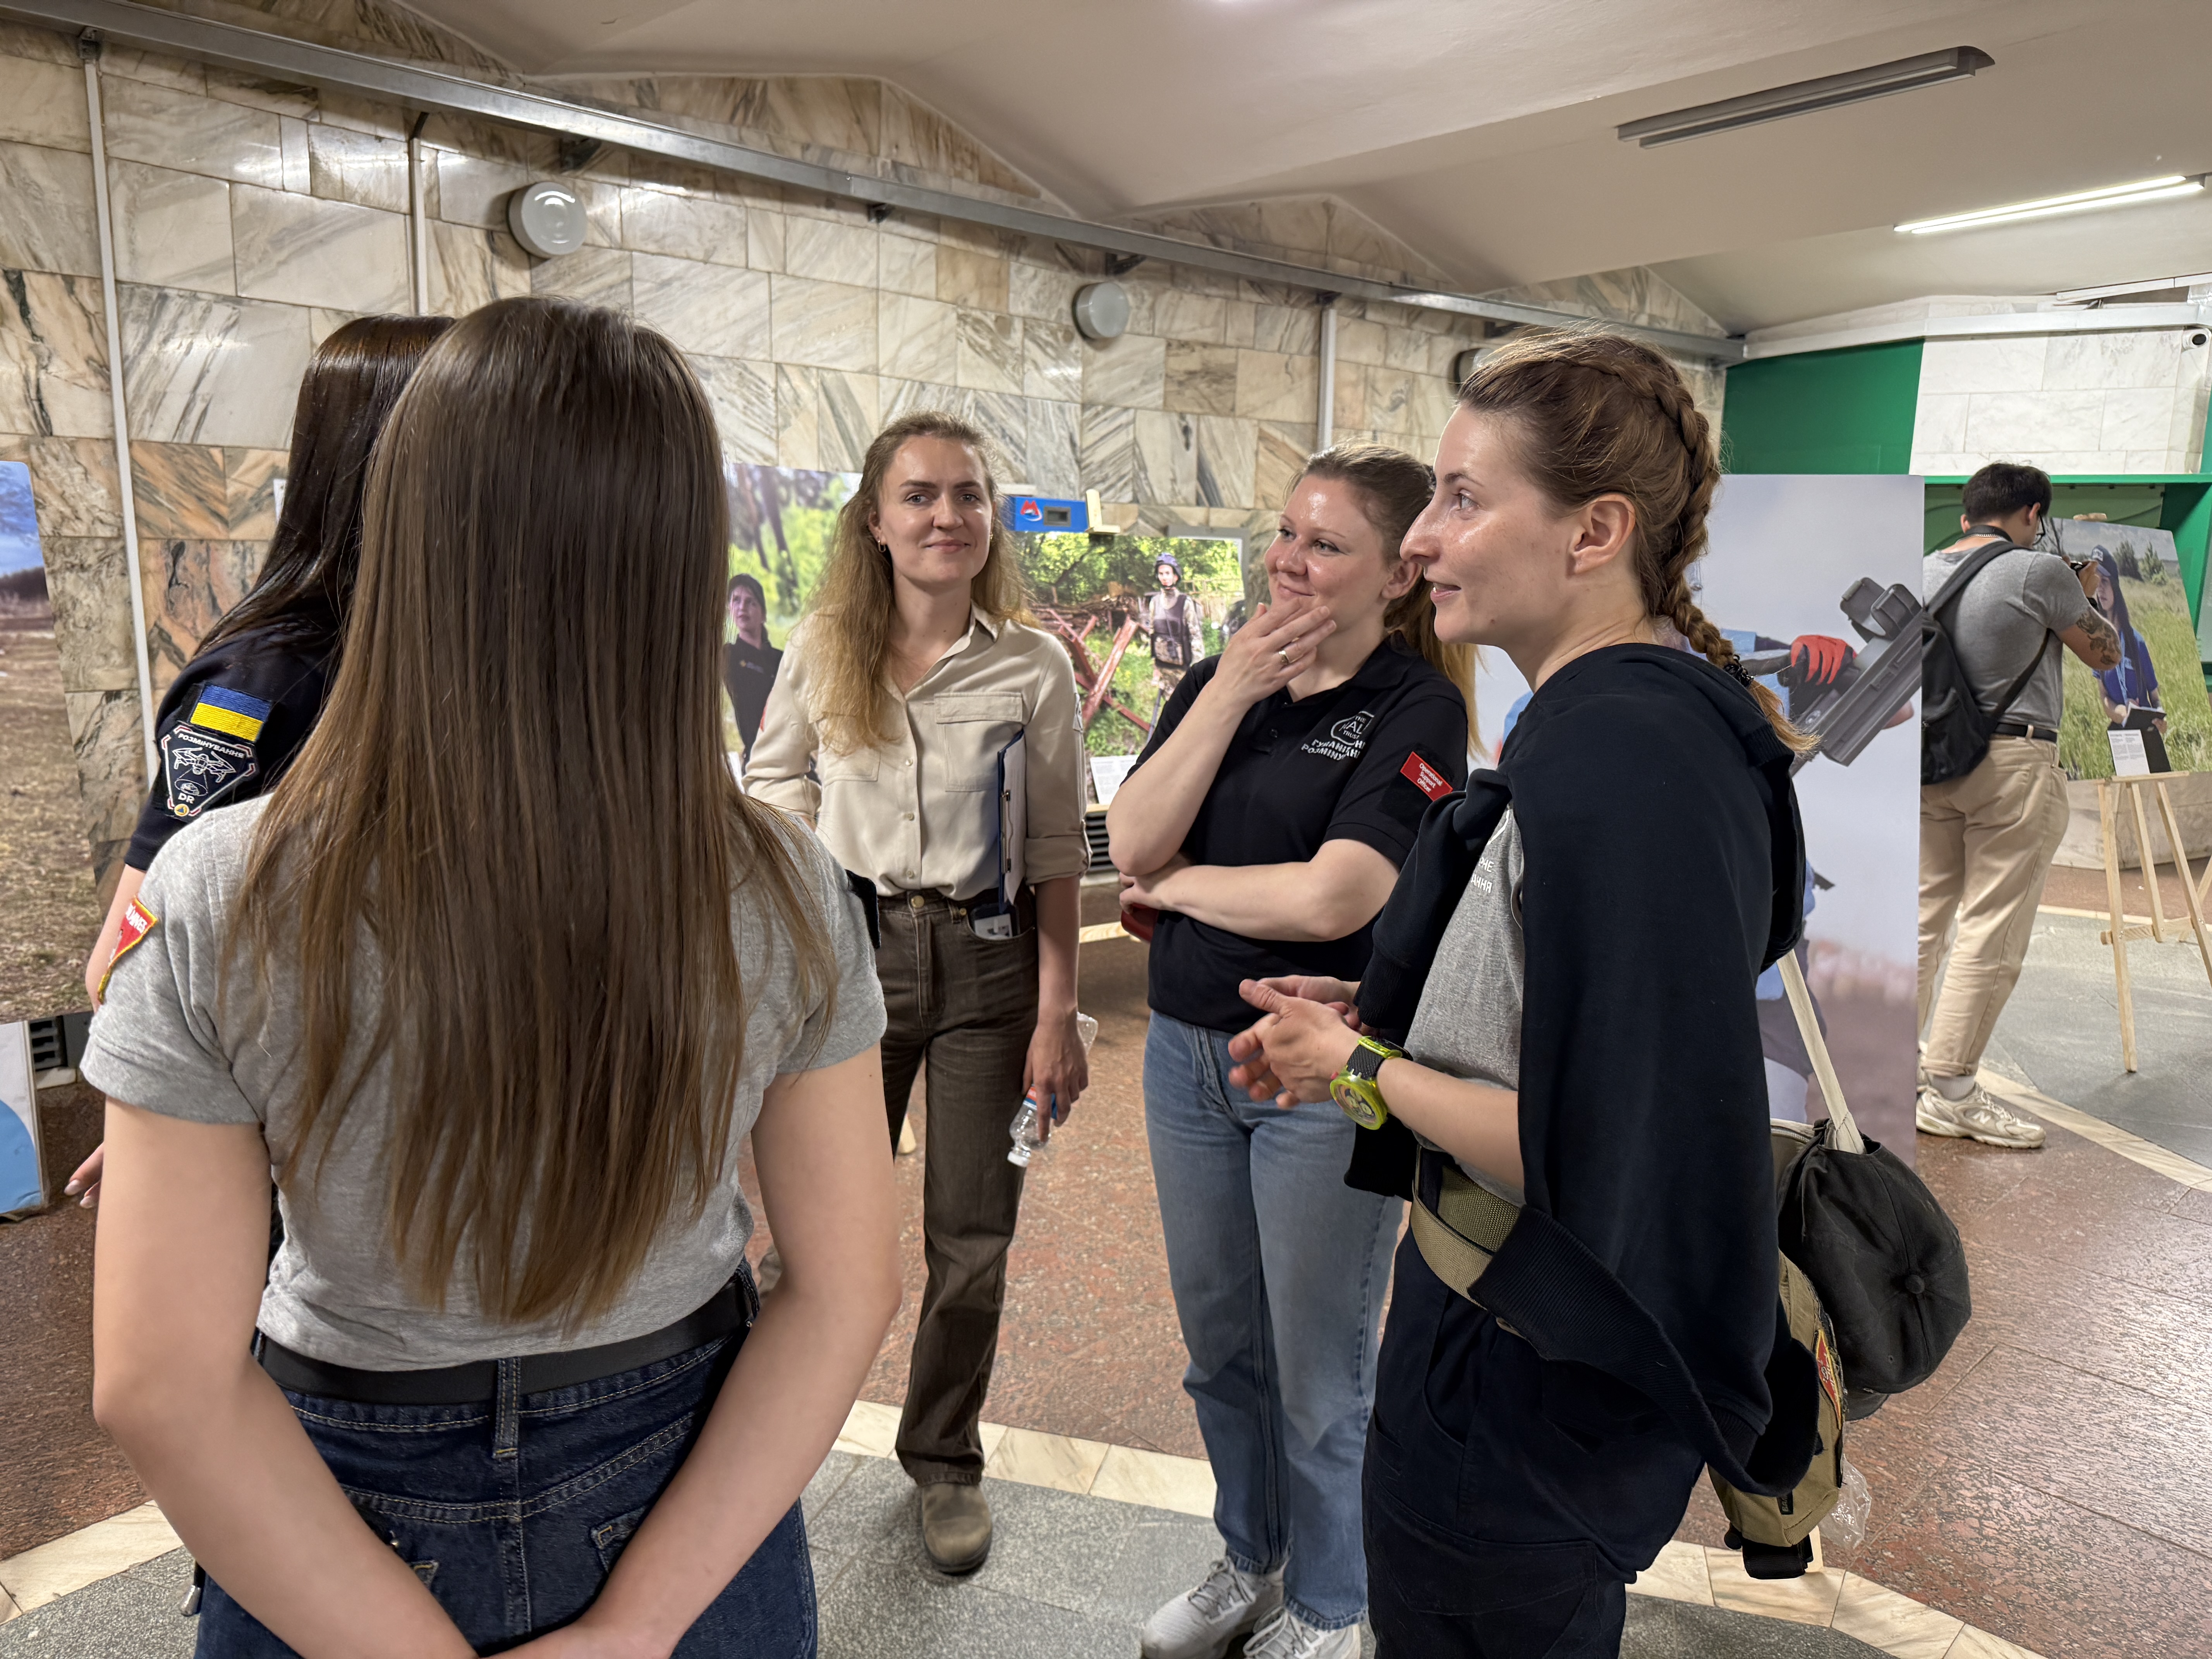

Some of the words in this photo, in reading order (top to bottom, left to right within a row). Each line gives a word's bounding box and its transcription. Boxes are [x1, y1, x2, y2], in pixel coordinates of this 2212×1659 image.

[1338, 721, 1362, 734] HAL
[1343, 730, 1360, 739] TRUST
[178, 733, 245, 759] РОЗМІНУВАННЯ
[1419, 763, 1443, 787] Operational
[1419, 771, 1436, 788] Support
[1417, 778, 1431, 792] Officer
[178, 792, 195, 804] DR
[1470, 873, 1492, 893] АННЯ
